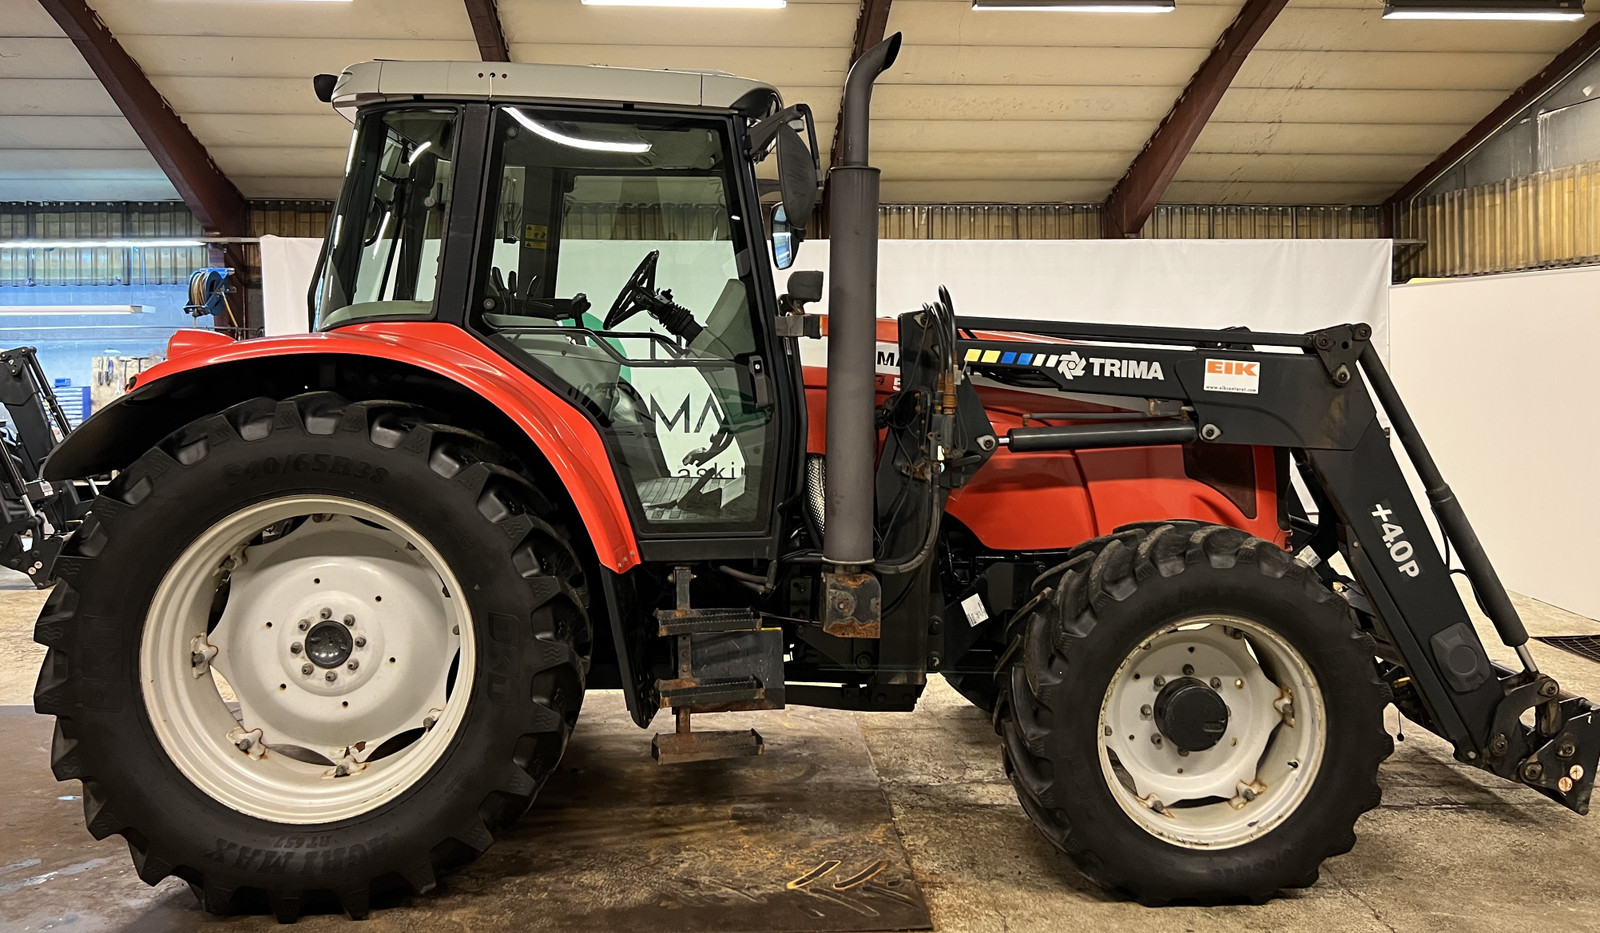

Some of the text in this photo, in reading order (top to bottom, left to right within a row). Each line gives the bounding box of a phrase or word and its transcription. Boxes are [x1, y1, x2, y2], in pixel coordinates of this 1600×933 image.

[876, 350, 901, 368] M
[1089, 357, 1165, 381] TRIMA
[1206, 360, 1258, 377] EIK
[225, 453, 390, 486] 540/65R38
[1371, 503, 1420, 578] +4.0P
